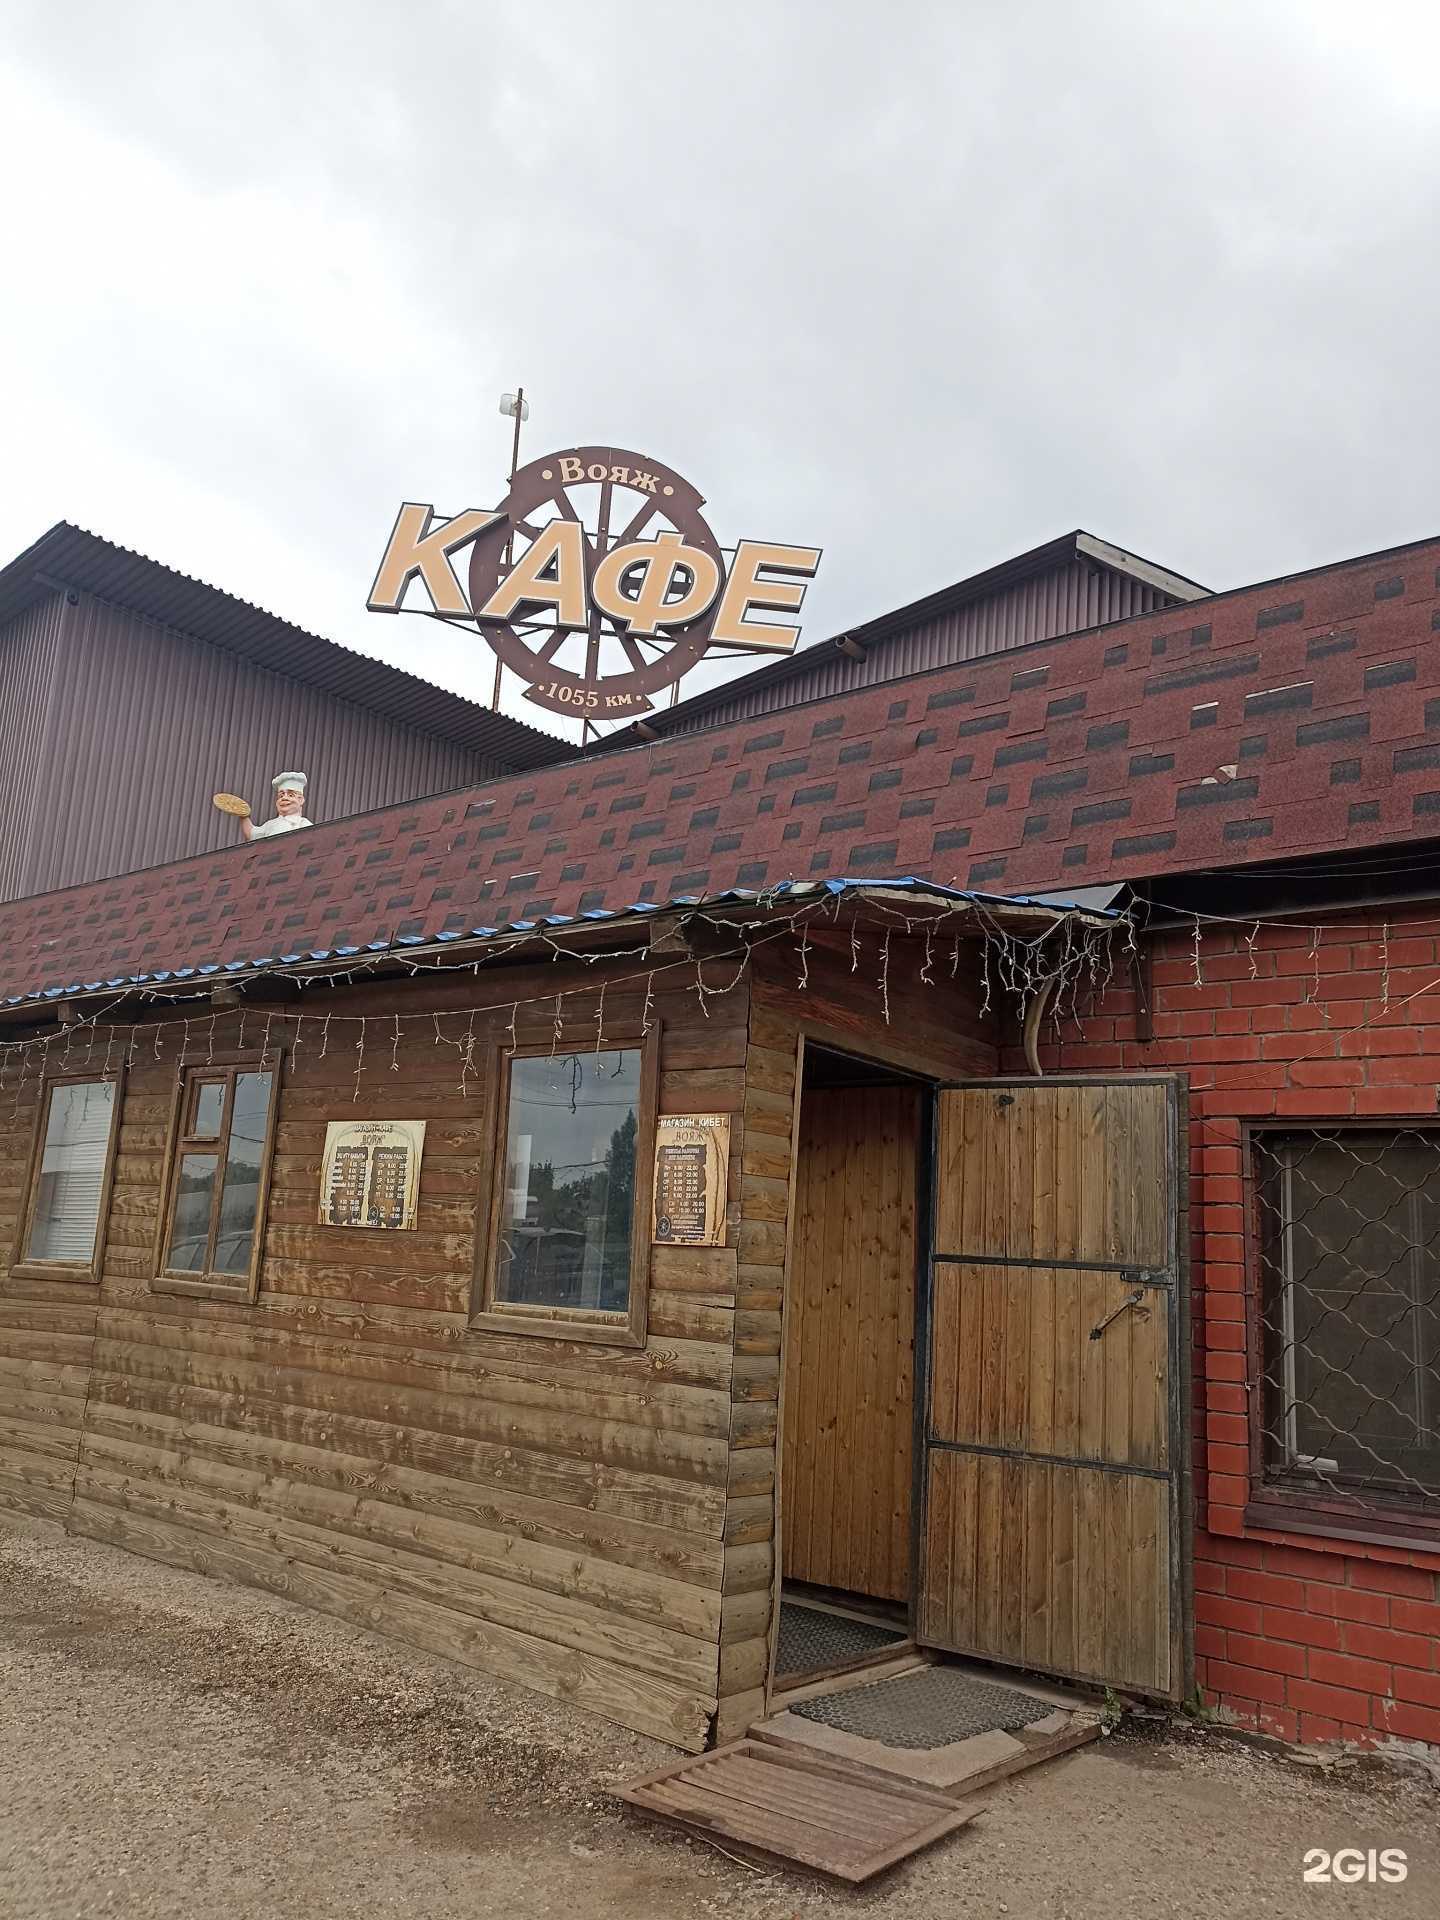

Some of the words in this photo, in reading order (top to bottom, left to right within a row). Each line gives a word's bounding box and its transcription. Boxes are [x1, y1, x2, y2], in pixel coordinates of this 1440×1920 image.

[558, 456, 662, 494] Вояж
[366, 502, 824, 655] КАФЕ
[545, 681, 599, 708] 1055
[605, 693, 632, 708] км
[660, 1118, 694, 1128] МАГАЗИН
[699, 1117, 725, 1127] КИБЕТ
